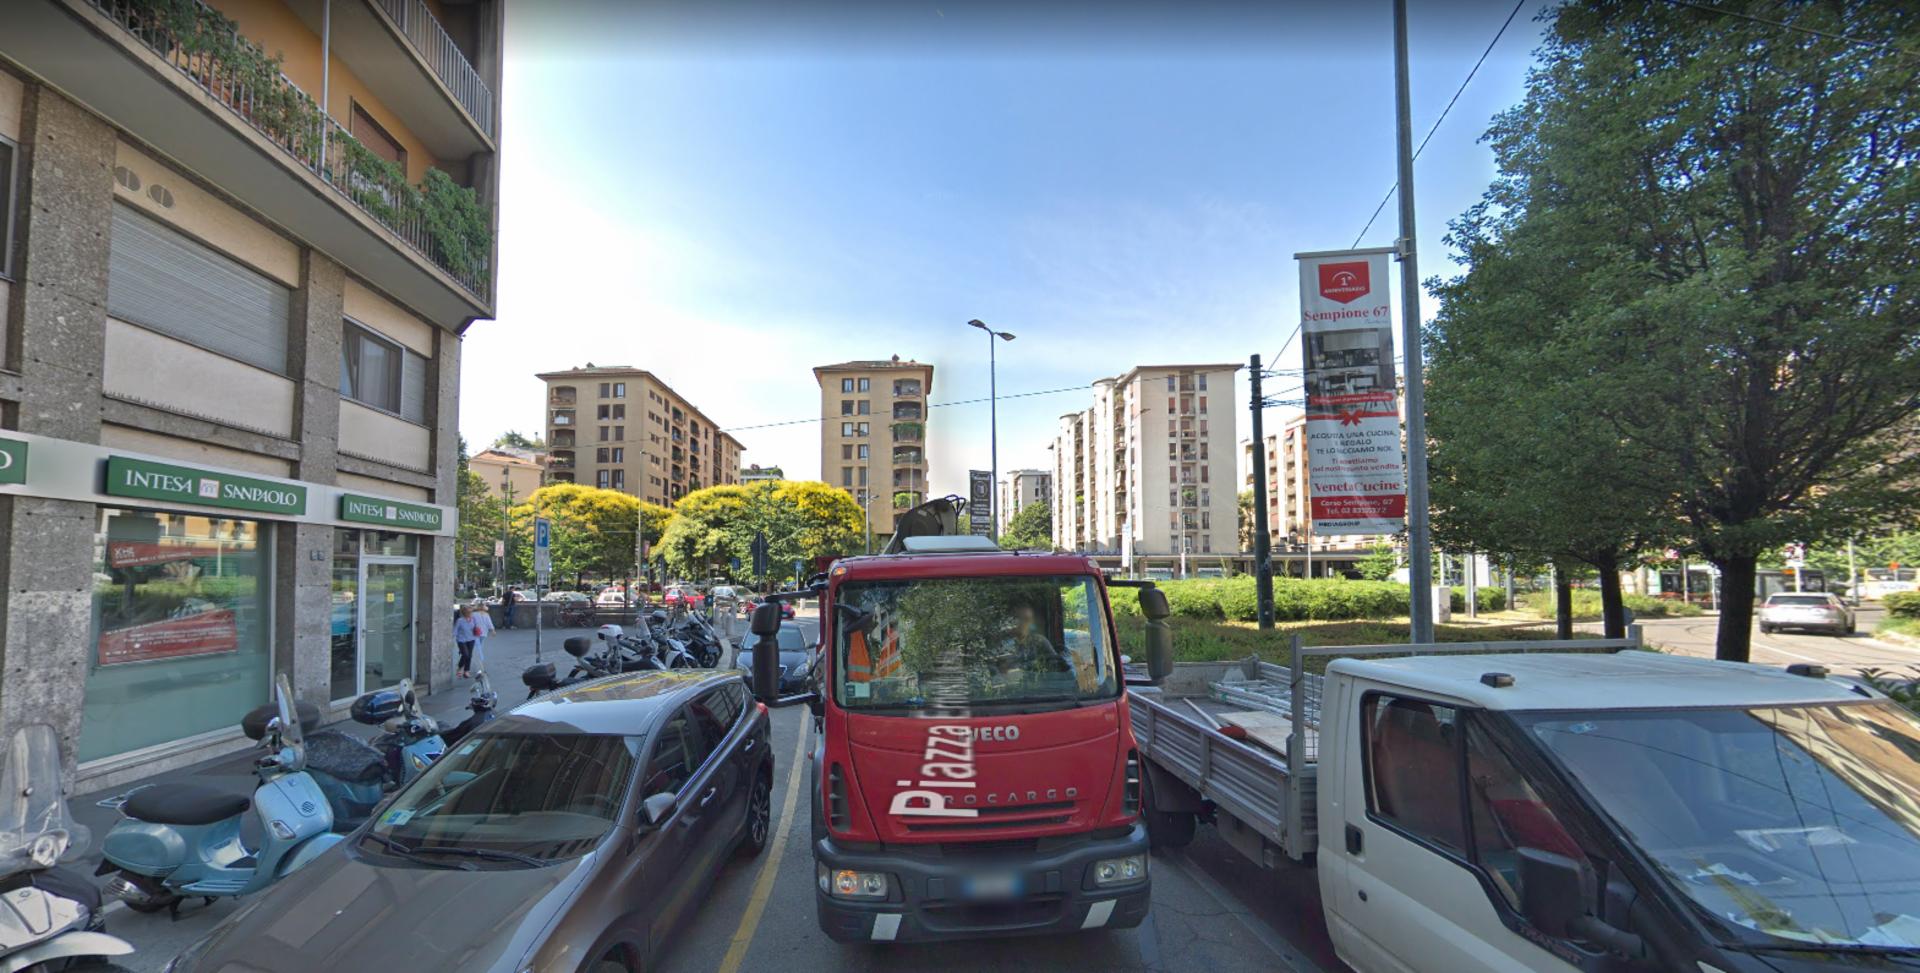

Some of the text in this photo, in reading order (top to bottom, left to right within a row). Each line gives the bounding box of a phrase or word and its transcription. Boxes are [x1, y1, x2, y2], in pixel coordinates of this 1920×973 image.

[1304, 308, 1369, 322] Sempione
[1373, 306, 1388, 317] 67
[126, 470, 296, 506] INTESA SANPAOLO
[349, 501, 439, 524] INTESA SANPAOLO
[540, 526, 546, 544] P
[968, 724, 1020, 742] VECO
